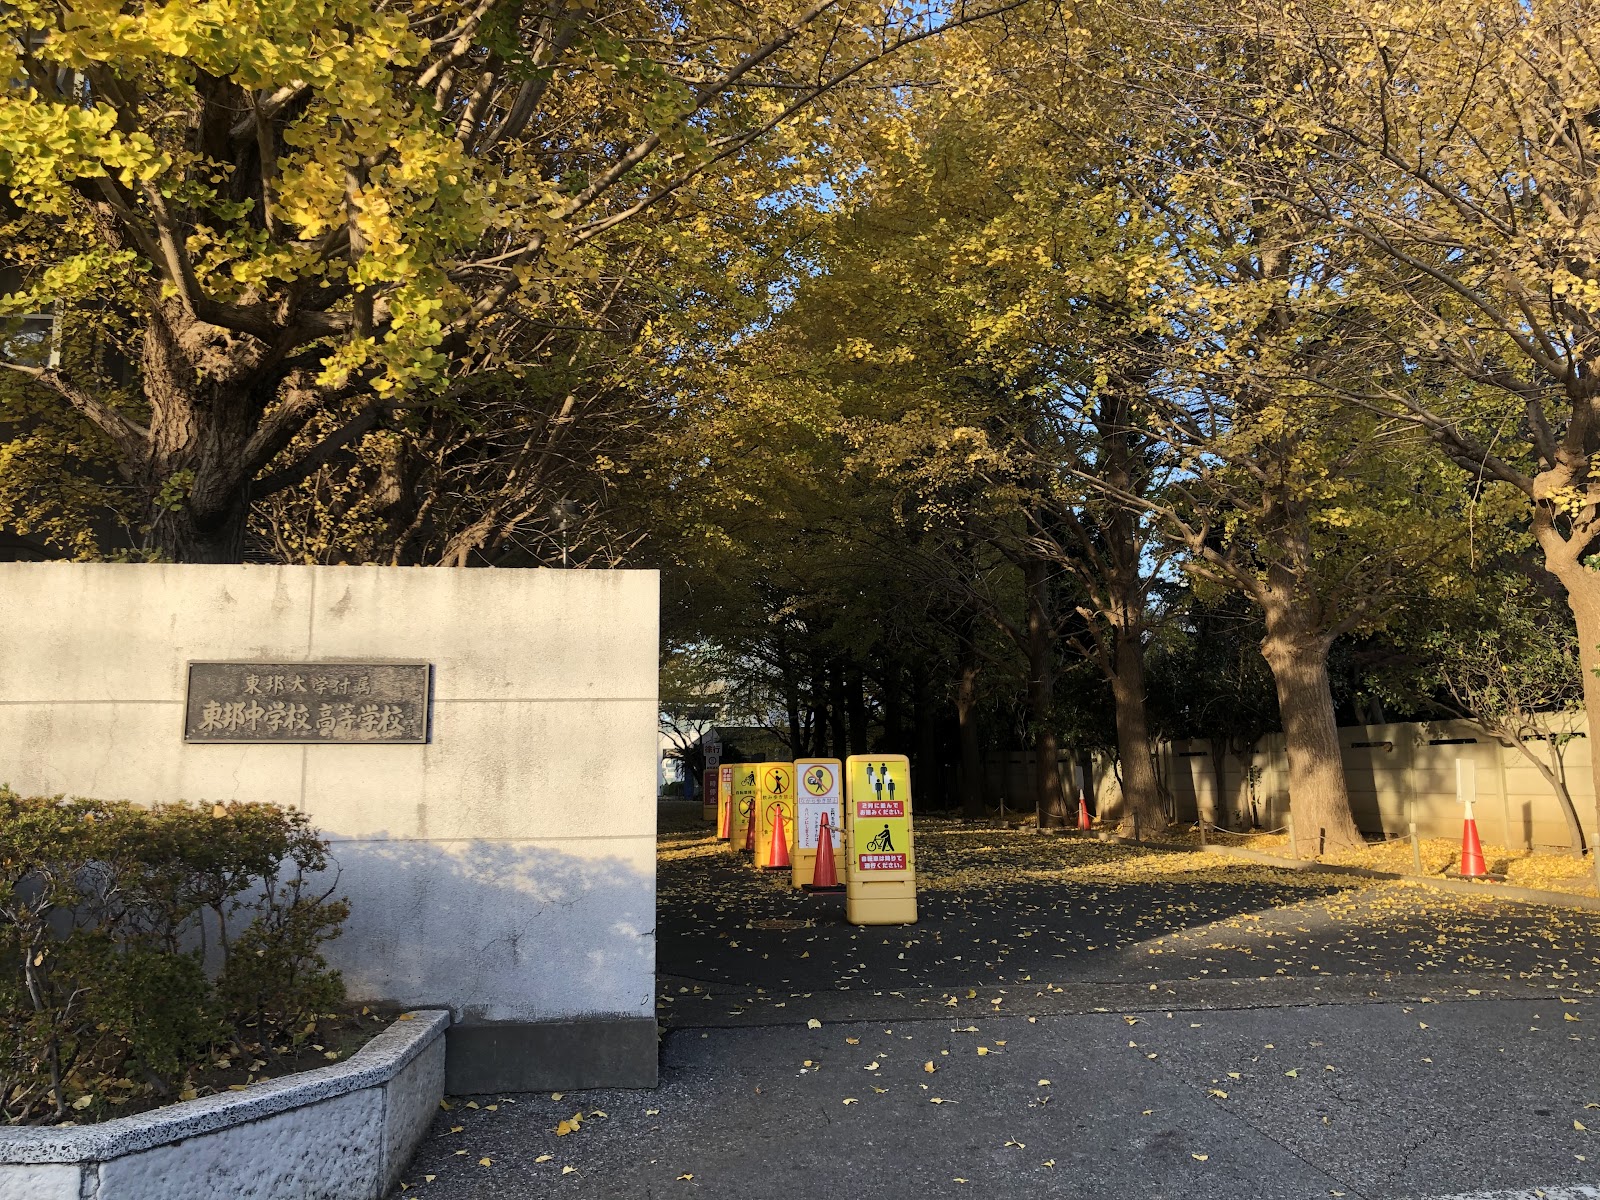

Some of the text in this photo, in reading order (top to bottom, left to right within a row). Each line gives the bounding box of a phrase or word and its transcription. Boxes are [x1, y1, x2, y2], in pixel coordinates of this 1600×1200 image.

[243, 673, 372, 695] 東邦大学付属
[705, 745, 721, 753] 徐行
[709, 774, 717, 804] 一時停止
